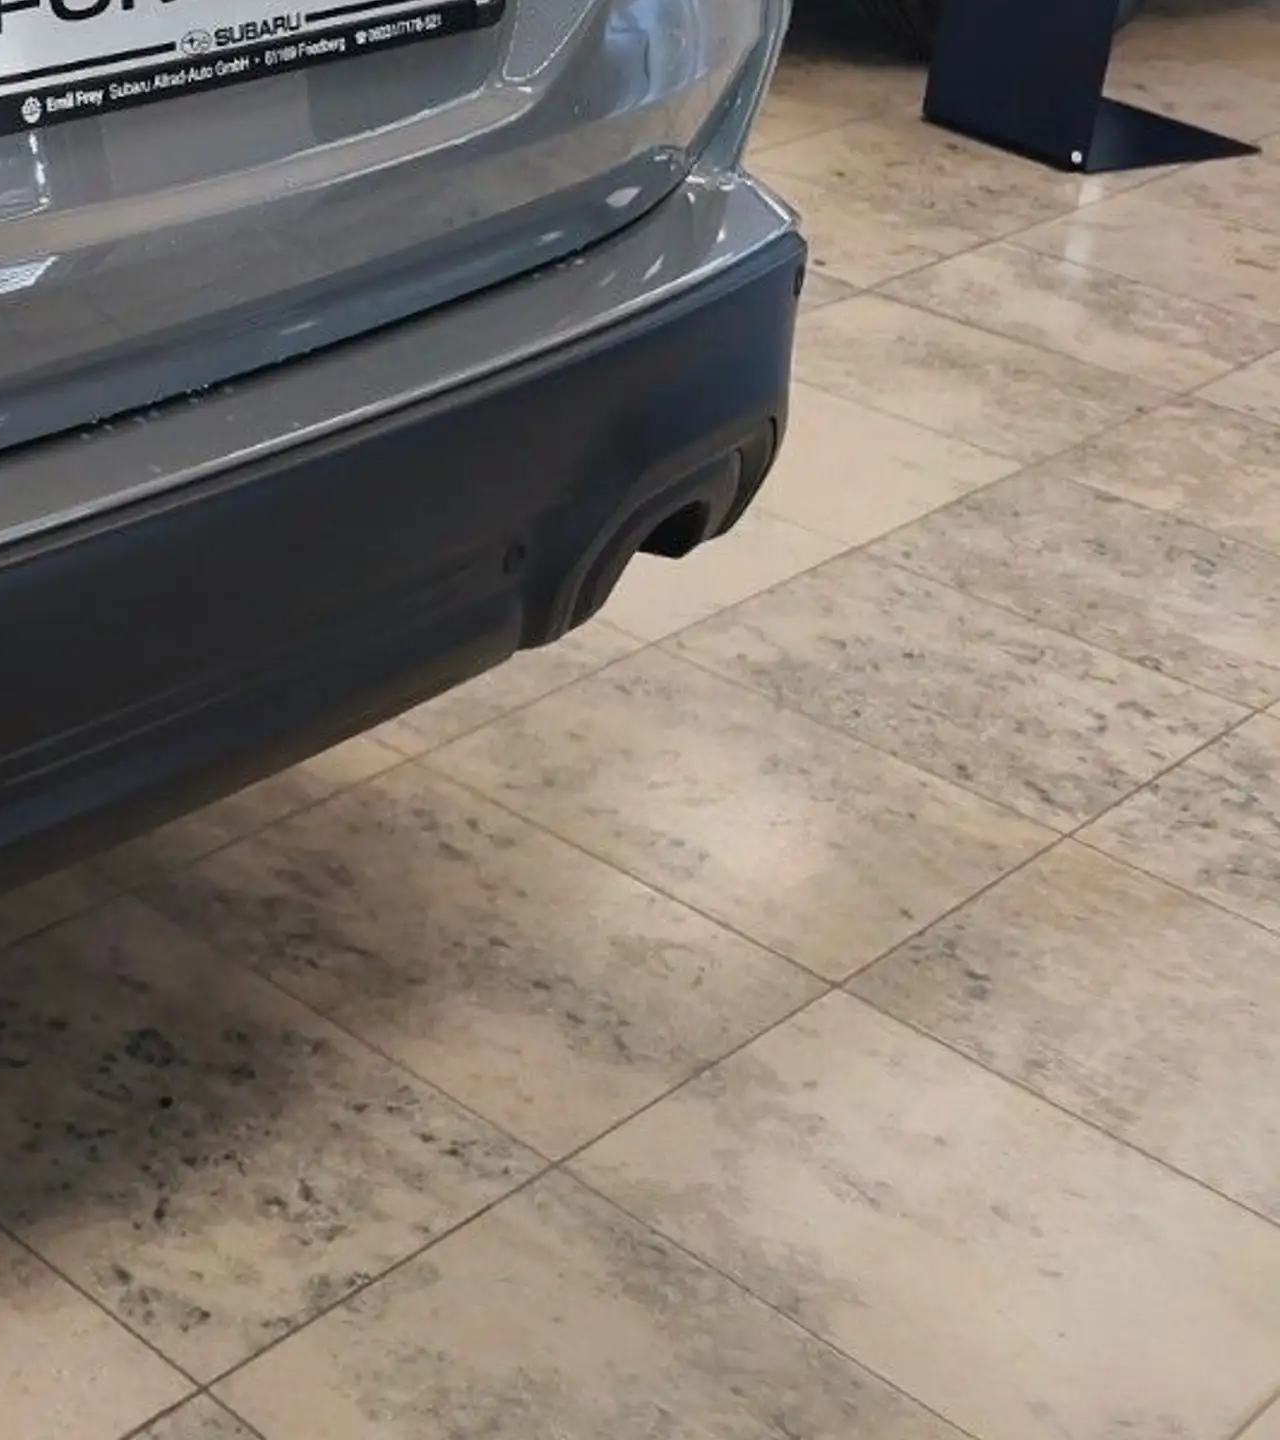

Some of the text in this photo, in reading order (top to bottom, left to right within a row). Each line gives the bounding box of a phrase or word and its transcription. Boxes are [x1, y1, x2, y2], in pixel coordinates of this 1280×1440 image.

[213, 13, 302, 47] SUBARU
[46, 90, 74, 112] Emil
[109, 80, 151, 100] Subaru
[214, 56, 250, 77] GmbH
